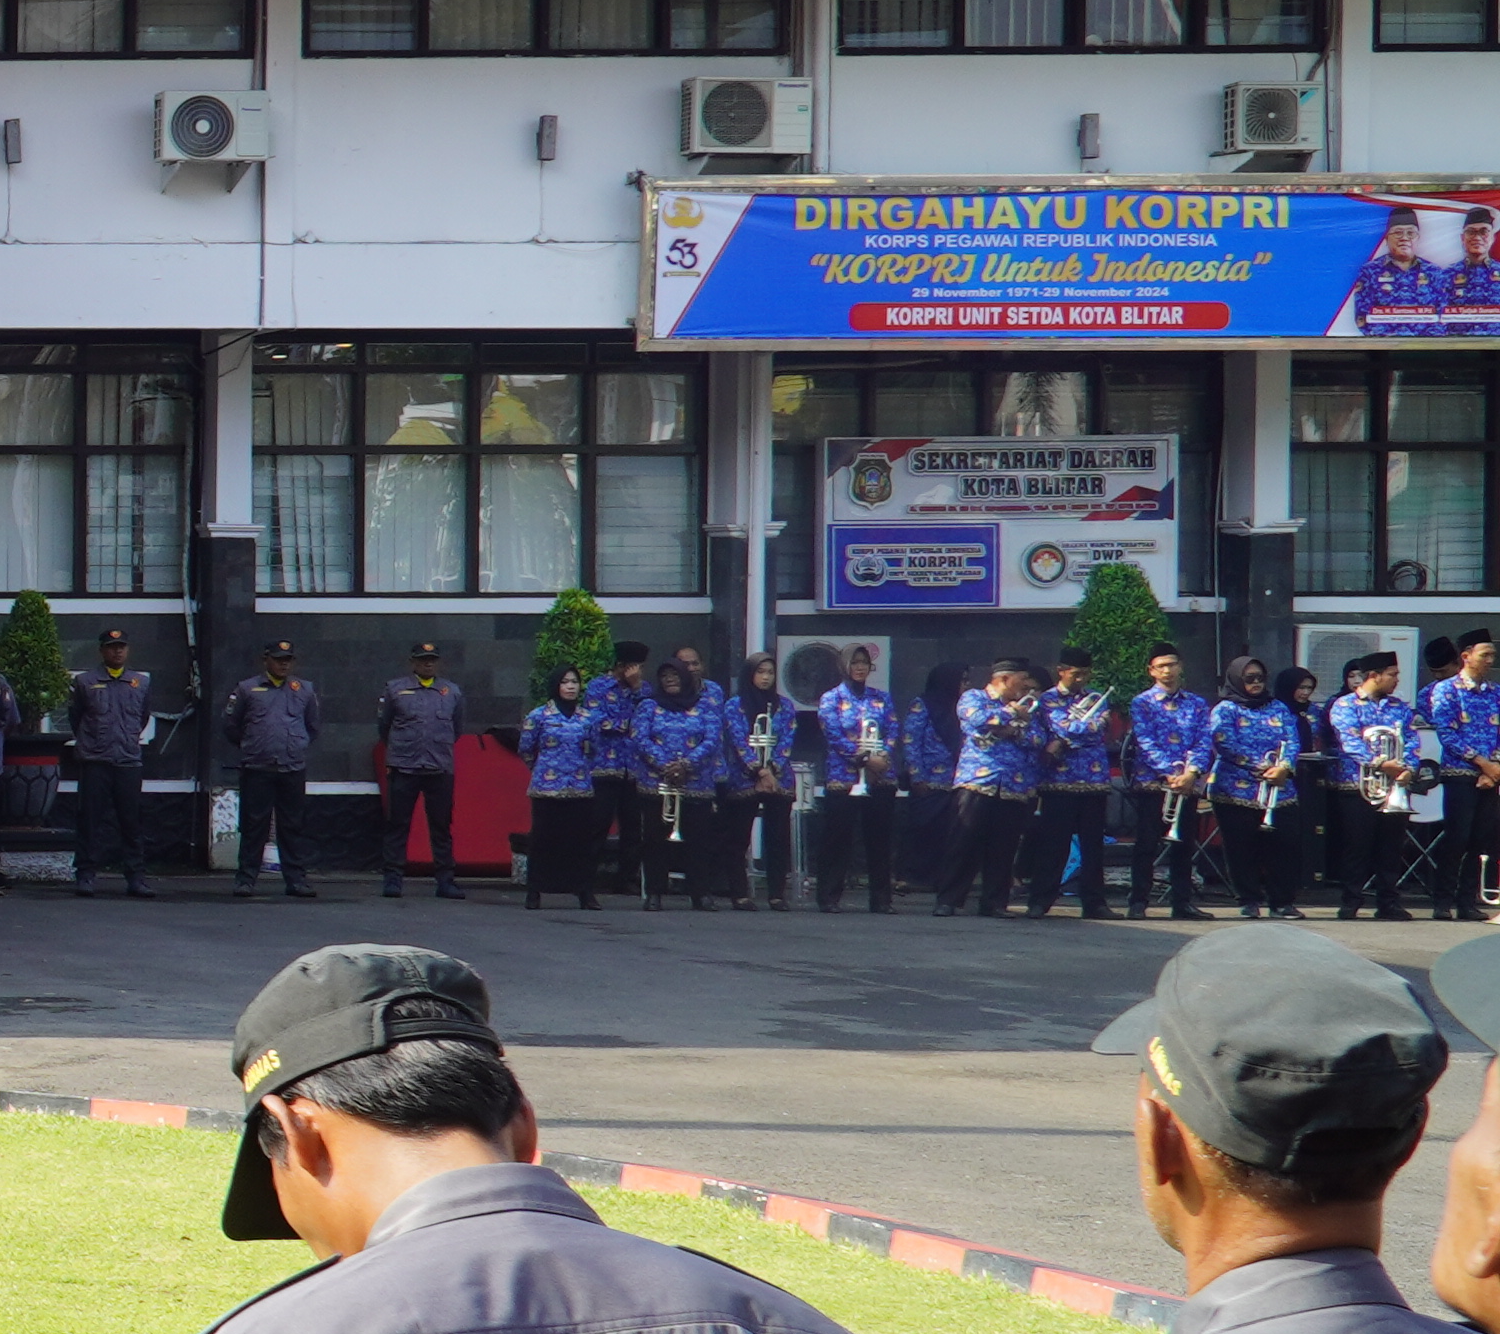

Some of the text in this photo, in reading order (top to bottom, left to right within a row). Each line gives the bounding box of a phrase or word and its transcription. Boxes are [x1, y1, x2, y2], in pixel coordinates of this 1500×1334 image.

[794, 195, 1290, 230] DIRGAHAYU KORPRI
[865, 233, 1218, 249] KORPS PEGAWAI REPUBLIK INDONESIA
[981, 253, 1083, 283] Untuk
[912, 287, 1170, 298] 29 November 1971-29 November 2024
[886, 307, 1183, 326] KORPRI UNIT SETDA KOTA BLITAR
[913, 448, 1155, 470] SEKRETARIAT DAERAH
[962, 476, 1105, 496] KOTA BLITAR
[908, 556, 963, 568] KORPRI
[1093, 550, 1124, 561] DWP
